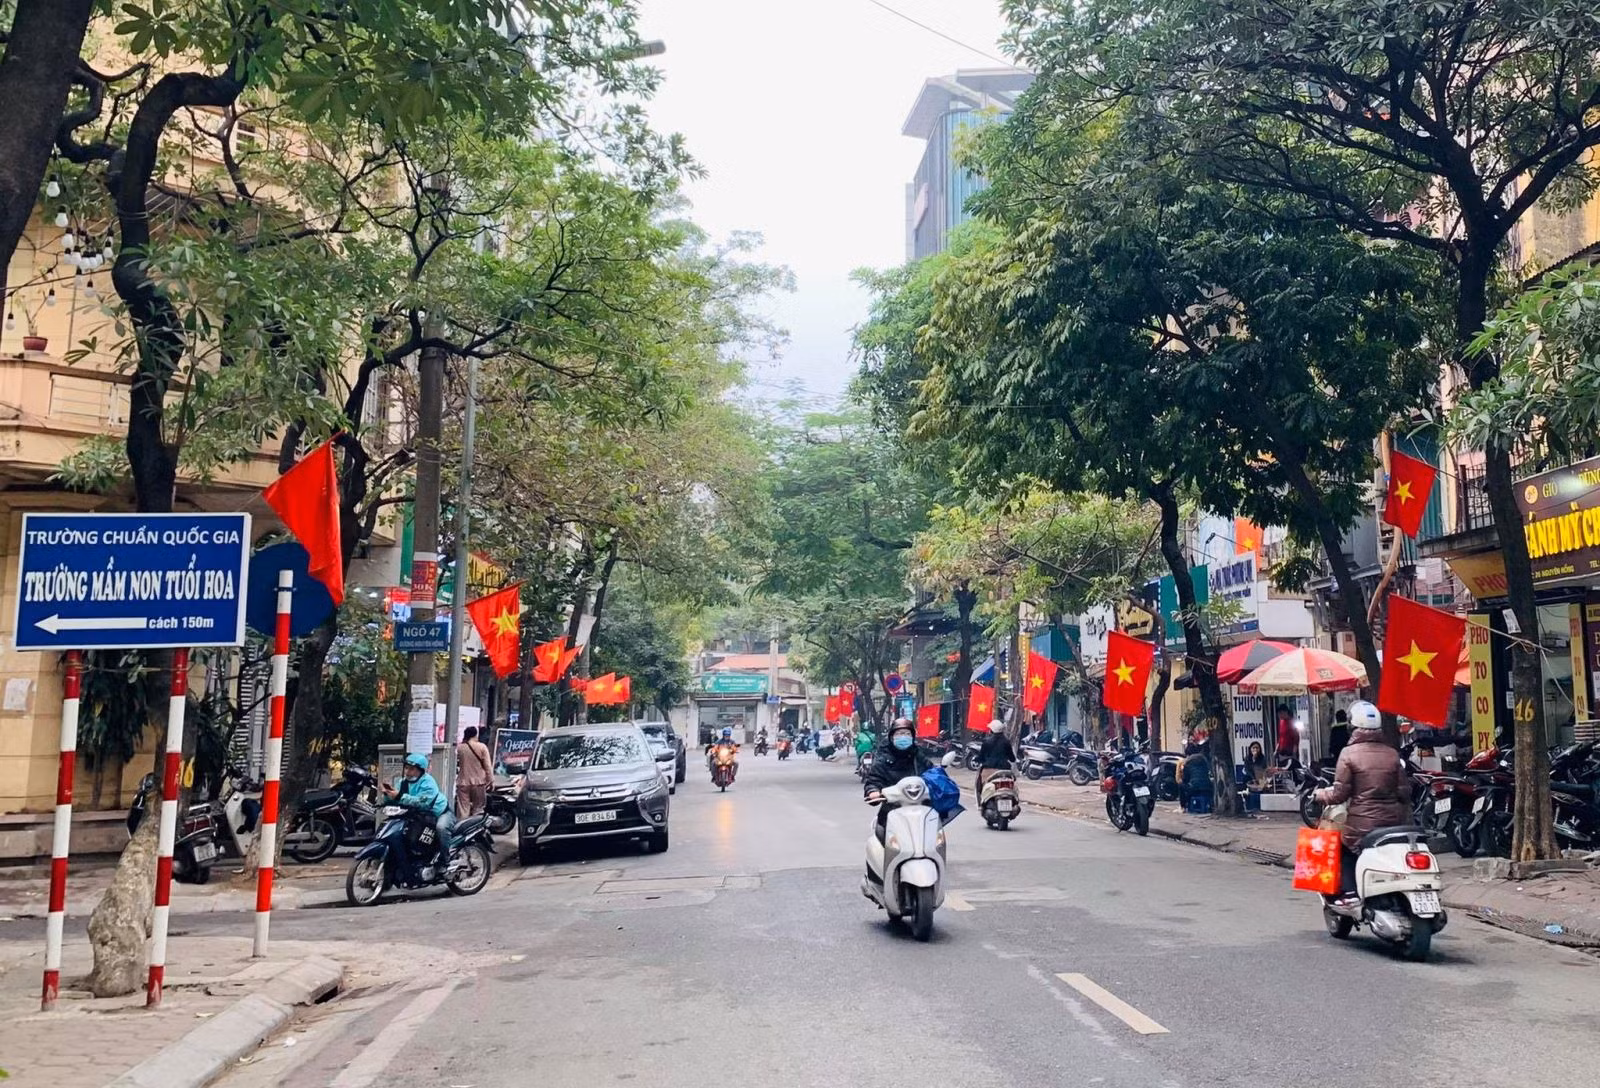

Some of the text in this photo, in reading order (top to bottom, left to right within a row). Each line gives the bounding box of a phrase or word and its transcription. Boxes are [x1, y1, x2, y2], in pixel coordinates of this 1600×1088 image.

[27, 526, 239, 546] TRƯỜNG CHUẨN QUỐC GIA
[1524, 511, 1558, 559] ÁNH
[25, 562, 88, 602] TRƯỜNG
[129, 570, 162, 601] NON
[165, 553, 200, 600] TUỔI
[203, 570, 234, 600] HOA
[149, 616, 214, 629] cách 150m
[429, 627, 441, 638] 47
[1470, 626, 1488, 644] PHO
[1474, 661, 1487, 679] TO
[1476, 697, 1489, 714] CO
[1515, 699, 1535, 722] 16
[1478, 732, 1490, 750] PY
